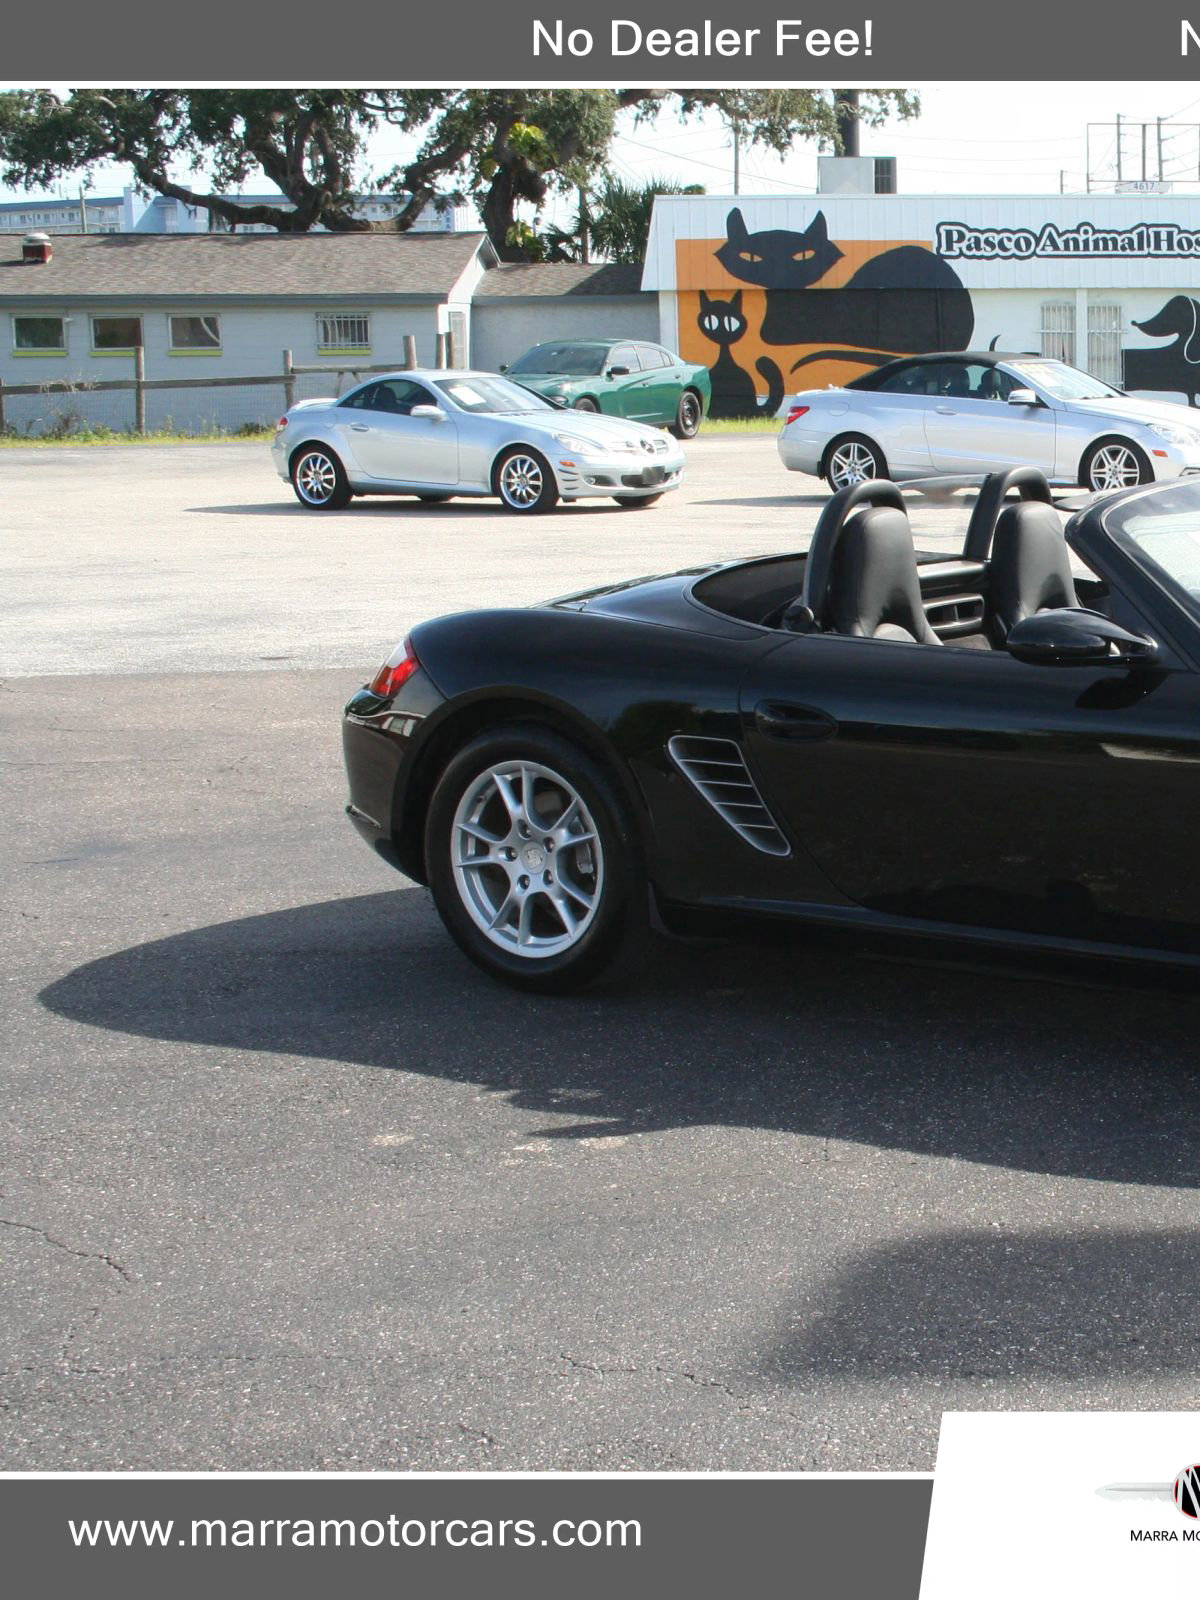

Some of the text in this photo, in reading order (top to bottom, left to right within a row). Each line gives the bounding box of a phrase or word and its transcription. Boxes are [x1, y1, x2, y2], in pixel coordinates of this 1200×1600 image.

[1133, 182, 1155, 191] 4617
[939, 226, 1036, 257] Pasco
[1036, 225, 1149, 256] Animal
